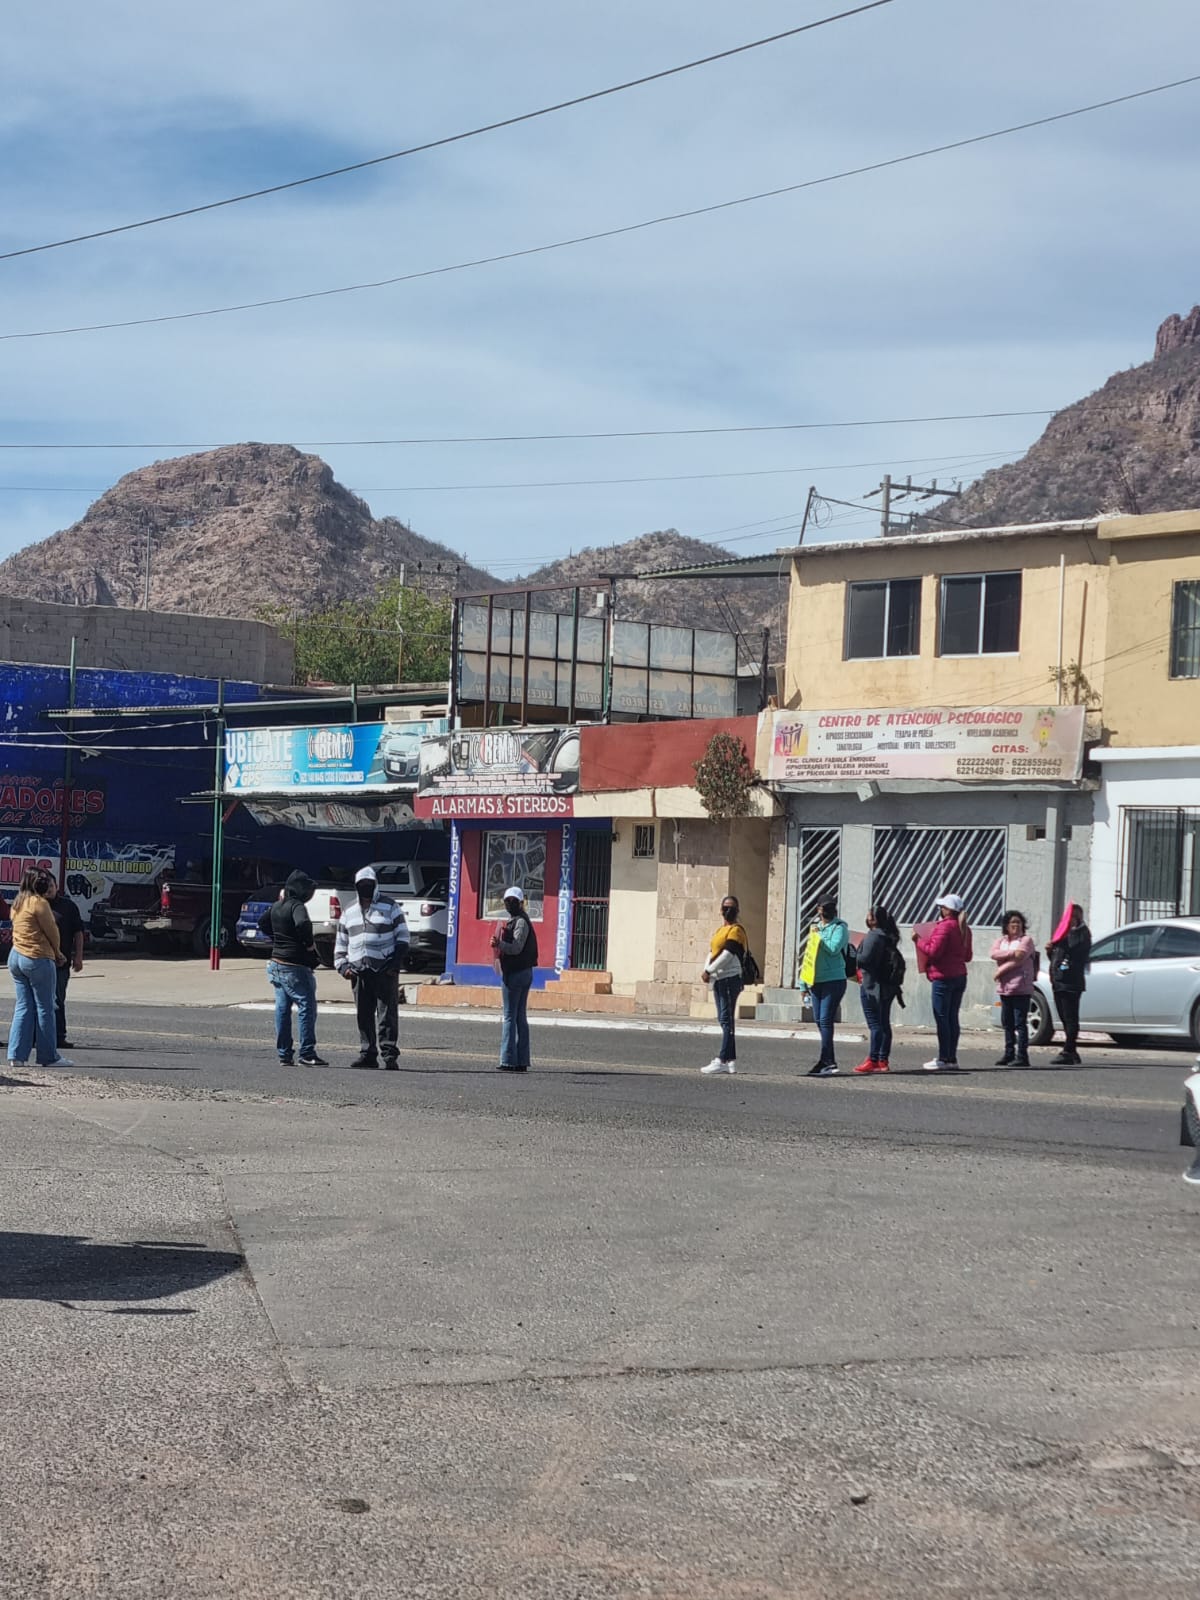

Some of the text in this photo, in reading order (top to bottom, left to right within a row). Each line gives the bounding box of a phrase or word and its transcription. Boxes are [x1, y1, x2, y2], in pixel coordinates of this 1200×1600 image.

[818, 715, 861, 728] CENTRO
[866, 714, 881, 726] DE
[947, 710, 1022, 725] PSICOLOGICO
[991, 744, 1029, 754] CITAS:
[241, 770, 262, 787] GPS
[432, 798, 495, 814] ALARMAS
[496, 799, 505, 815] &
[65, 858, 97, 872] 100%
[100, 860, 123, 873] ANTI
[447, 826, 460, 938] LUCES LED
